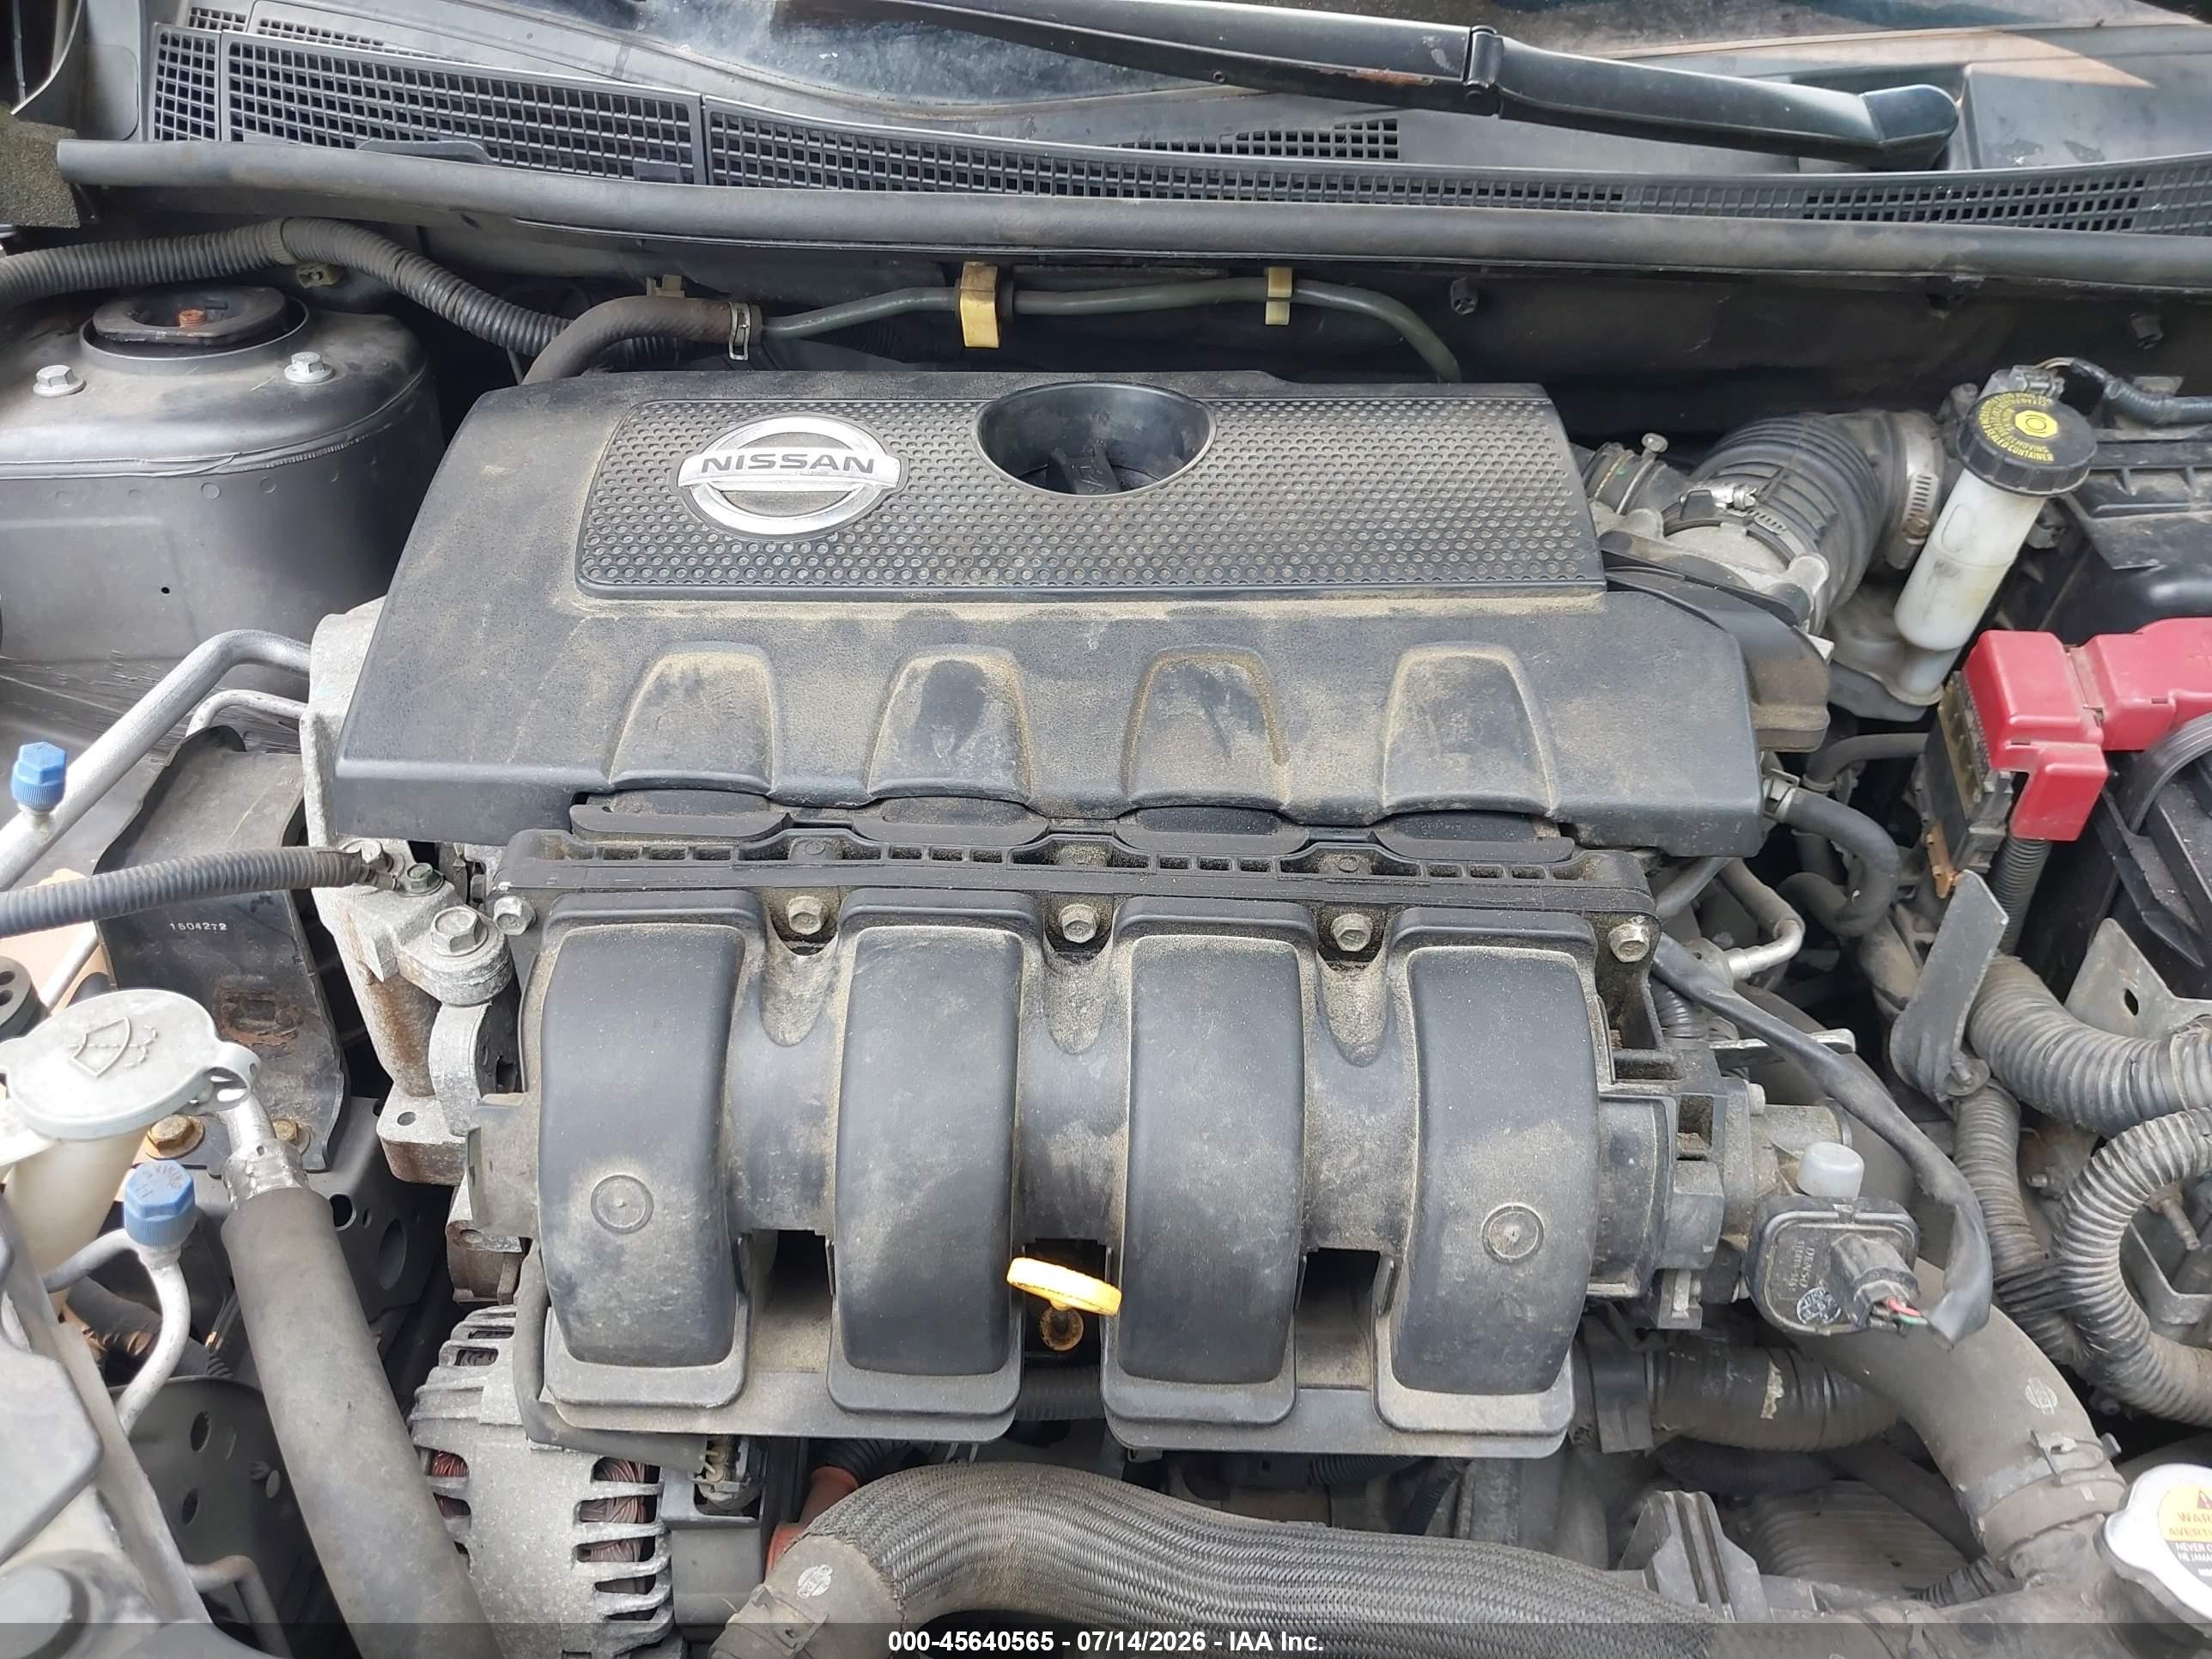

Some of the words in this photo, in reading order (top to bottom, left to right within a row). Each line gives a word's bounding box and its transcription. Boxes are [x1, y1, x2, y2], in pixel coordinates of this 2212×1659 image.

[2008, 445, 2054, 462] CONTAINER
[701, 453, 874, 474] NISSAN
[169, 921, 228, 931] 1504272
[1799, 1247, 1815, 1288] DENSO
